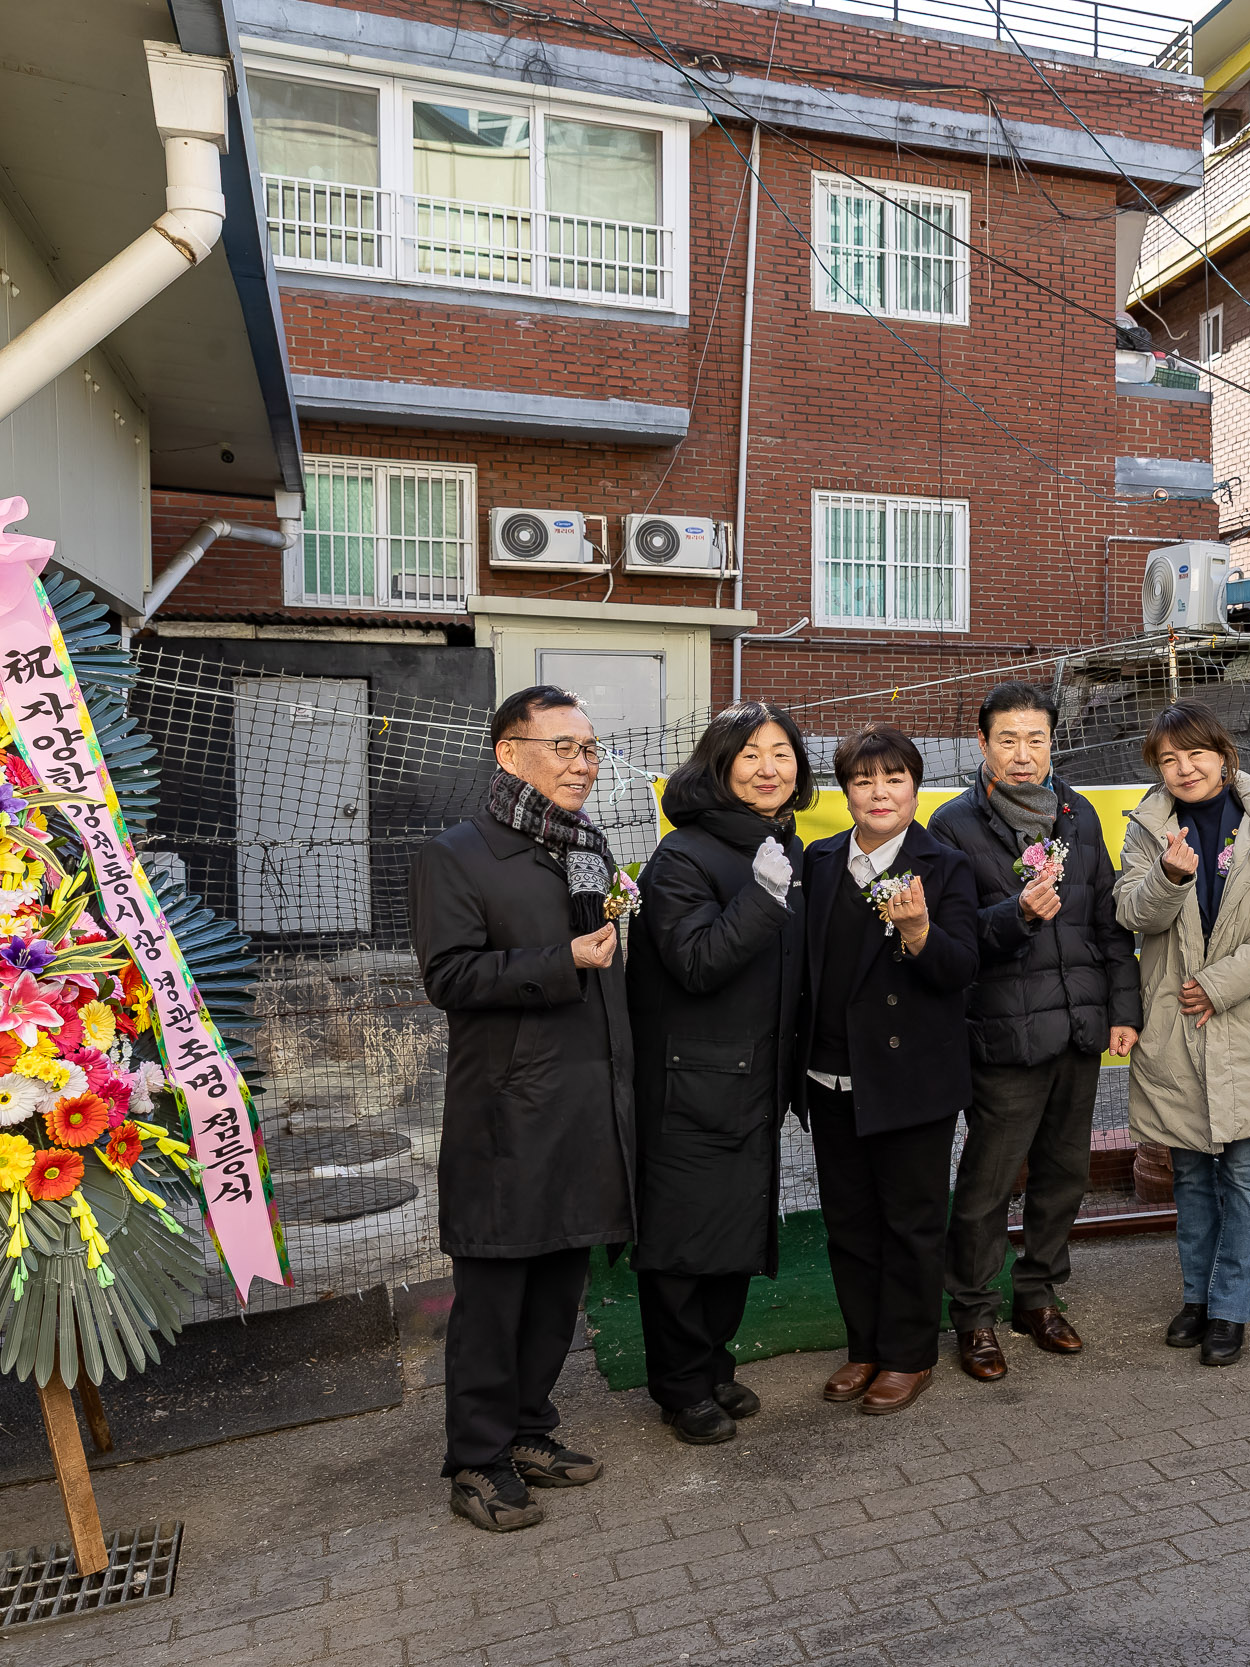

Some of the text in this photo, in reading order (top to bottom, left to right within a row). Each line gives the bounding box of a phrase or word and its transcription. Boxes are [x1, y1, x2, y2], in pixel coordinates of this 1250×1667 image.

[2, 645, 64, 684] 祝
[18, 692, 165, 961] 자양한강전통시장
[198, 1107, 253, 1204] 점등식
